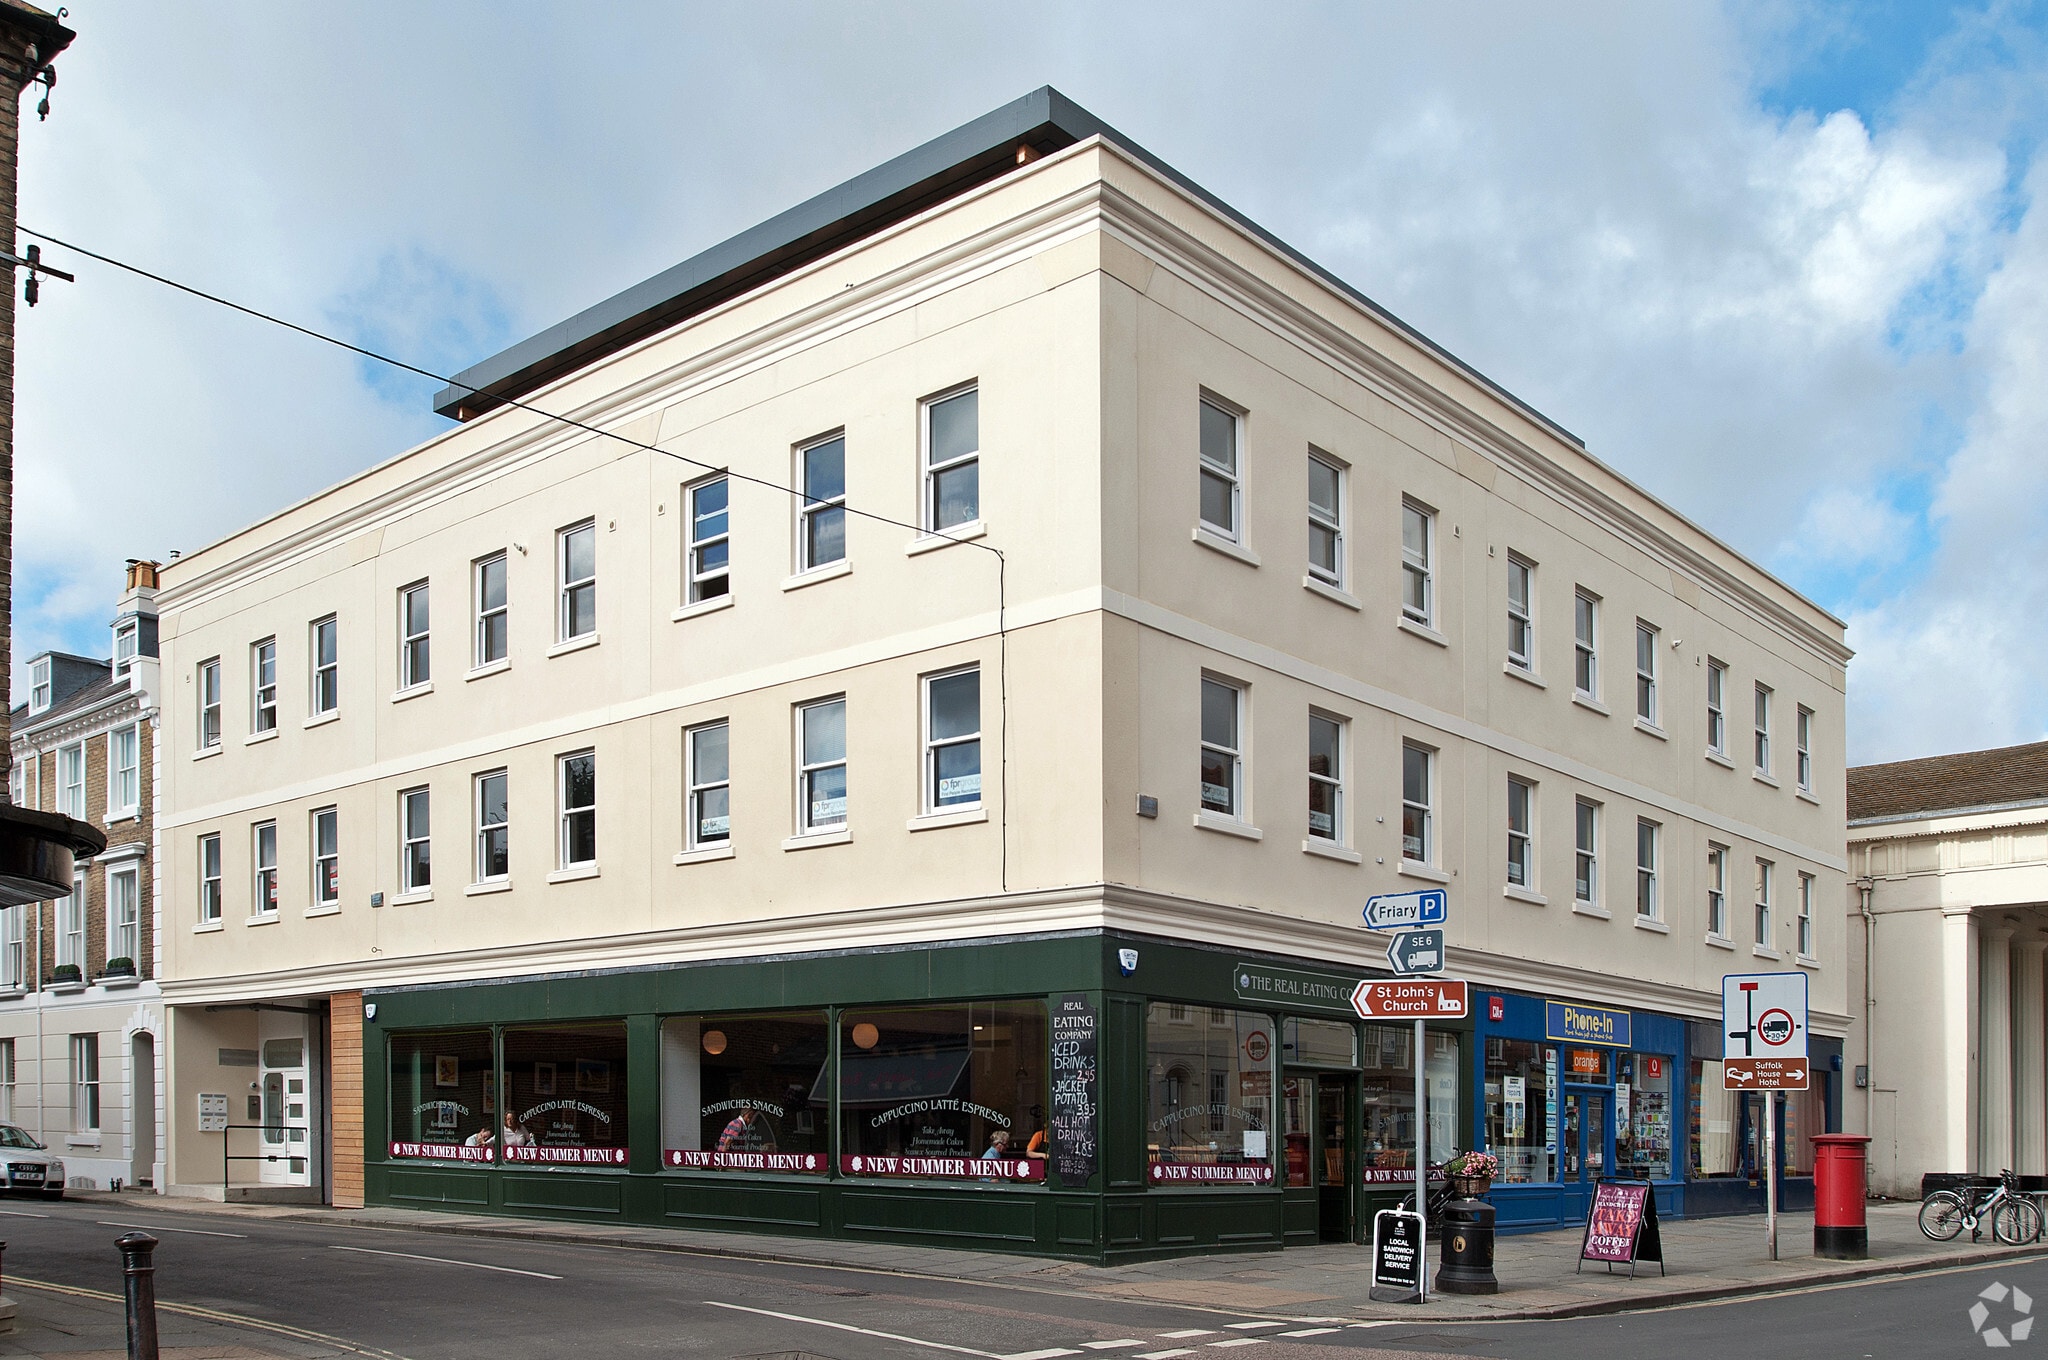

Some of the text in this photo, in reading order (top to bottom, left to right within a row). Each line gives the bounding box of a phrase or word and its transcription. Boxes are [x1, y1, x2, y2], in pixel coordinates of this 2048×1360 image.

[1379, 899, 1436, 918] Friary P
[1412, 937, 1432, 947] SE 6
[1251, 976, 1272, 991] THE
[1274, 979, 1300, 995] REAL
[1303, 982, 1337, 1000] EATING
[1377, 986, 1434, 998] St John's
[1063, 1001, 1084, 1011] REAL
[1382, 1000, 1428, 1011] Church
[1053, 1015, 1093, 1028] EATING
[1564, 1007, 1613, 1034] Phone-In
[1054, 1030, 1092, 1040] COMPANY
[1054, 1041, 1080, 1057] ICED
[1054, 1055, 1096, 1070] DRINKS
[1574, 1056, 1599, 1071] orange
[1055, 1080, 1088, 1093] JACKET
[1055, 1092, 1088, 1106] POTATO
[413, 1101, 469, 1116] SANDWICHES SNACKS
[518, 1099, 610, 1124] CAPPUCCINO LATTÉ ESPRESSO
[701, 1099, 784, 1118] SANDWICHES SNACKS
[871, 1098, 1011, 1129] CAPPUCCINO LATTÉ ESPRESSO
[1054, 1115, 1090, 1128] ALL HOT
[1152, 1105, 1205, 1132] CAPPUCCINO
[910, 1136, 964, 1147] Homemade Cakes
[1057, 1129, 1094, 1143] DRINKS
[402, 1143, 485, 1160] NEW SUMMER MENU
[516, 1147, 613, 1163] NEW SUMMER MENU
[685, 1151, 804, 1170] NEW SUMMER MENU
[866, 1157, 1015, 1177] NEW SUMMER MENU
[1165, 1166, 1263, 1180] NEW SUMMER MENU
[1373, 1170, 1392, 1181] NEW
[1393, 1170, 1416, 1181] SUMM
[1597, 1208, 1639, 1222] TAKE
[1595, 1221, 1633, 1237] AWAY
[1389, 1238, 1409, 1246] LOCAL
[1591, 1235, 1632, 1248] COFFEE
[1383, 1245, 1415, 1255] SANDWICH
[1598, 1247, 1621, 1256] TO GO
[1384, 1253, 1412, 1262] DELIVERY
[1385, 1261, 1410, 1270] SERVICE
